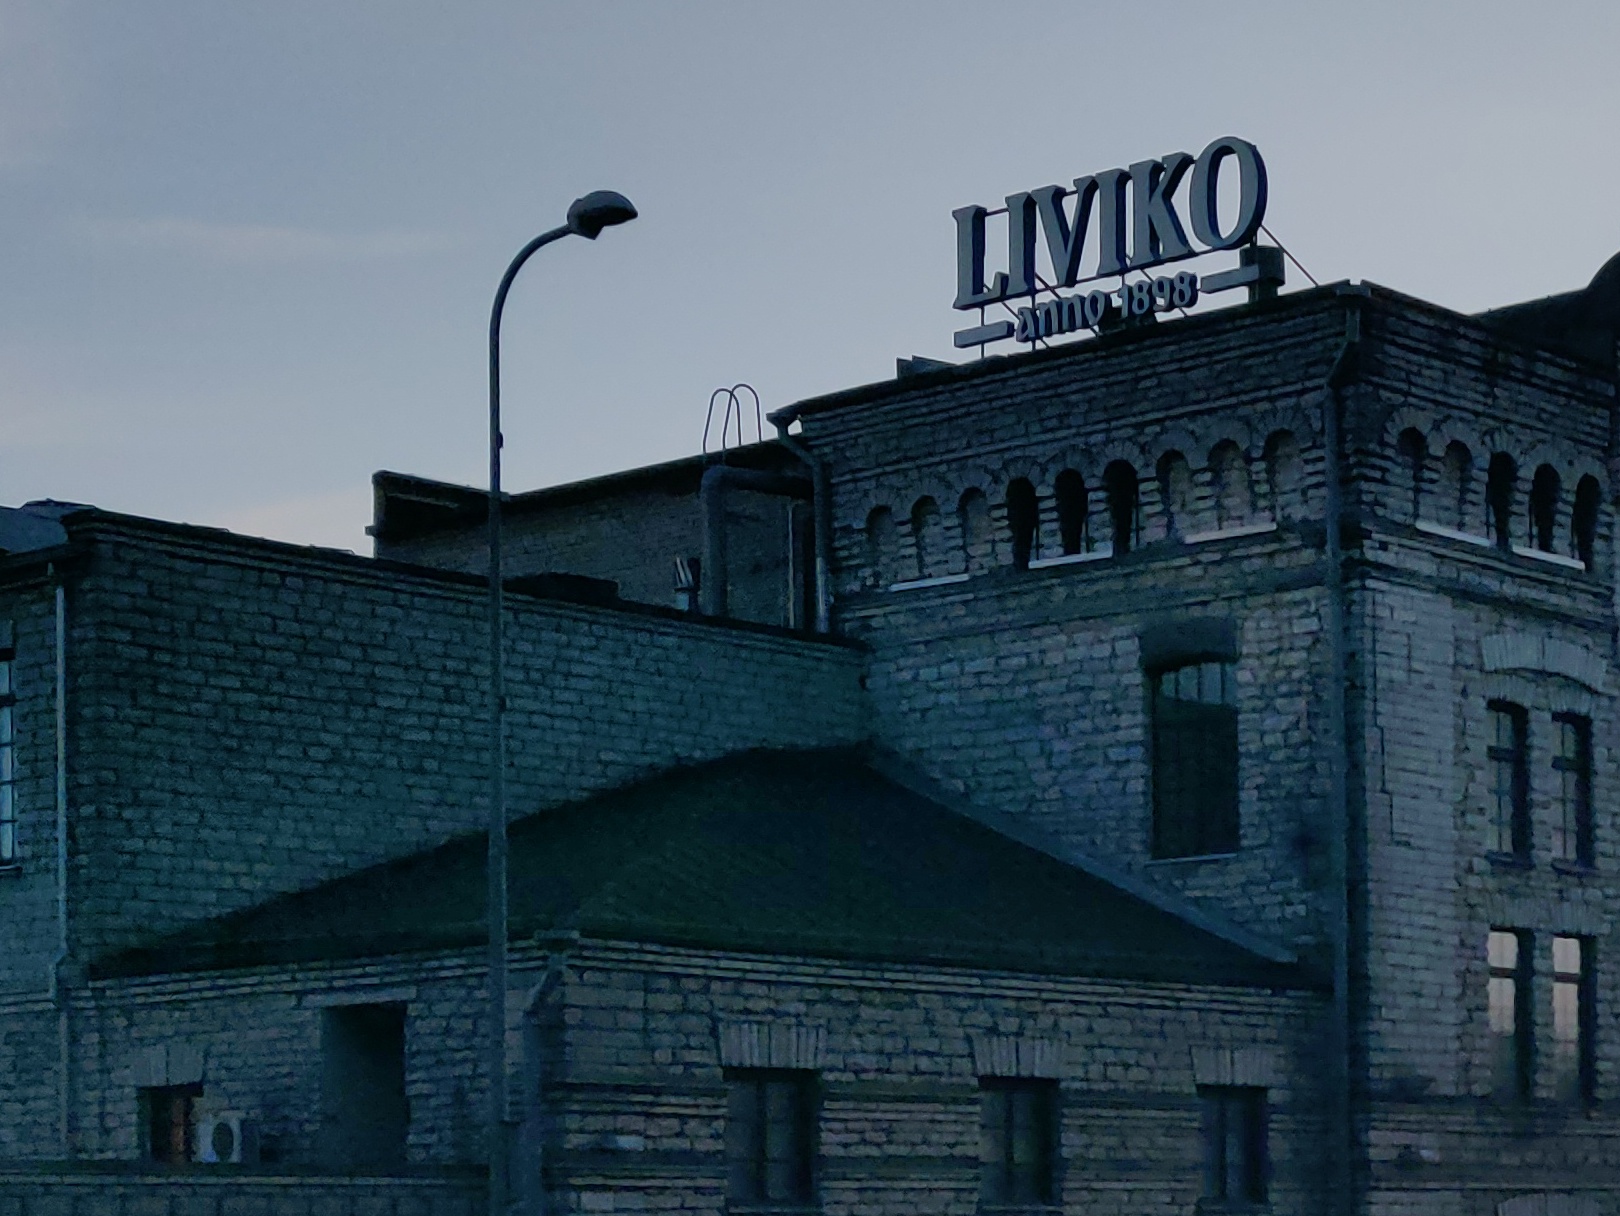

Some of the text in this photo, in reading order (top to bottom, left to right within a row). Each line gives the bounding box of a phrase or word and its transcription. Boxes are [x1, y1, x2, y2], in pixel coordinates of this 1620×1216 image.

[952, 136, 1267, 309] LIVIKO
[1016, 271, 1199, 343] anno 1898
